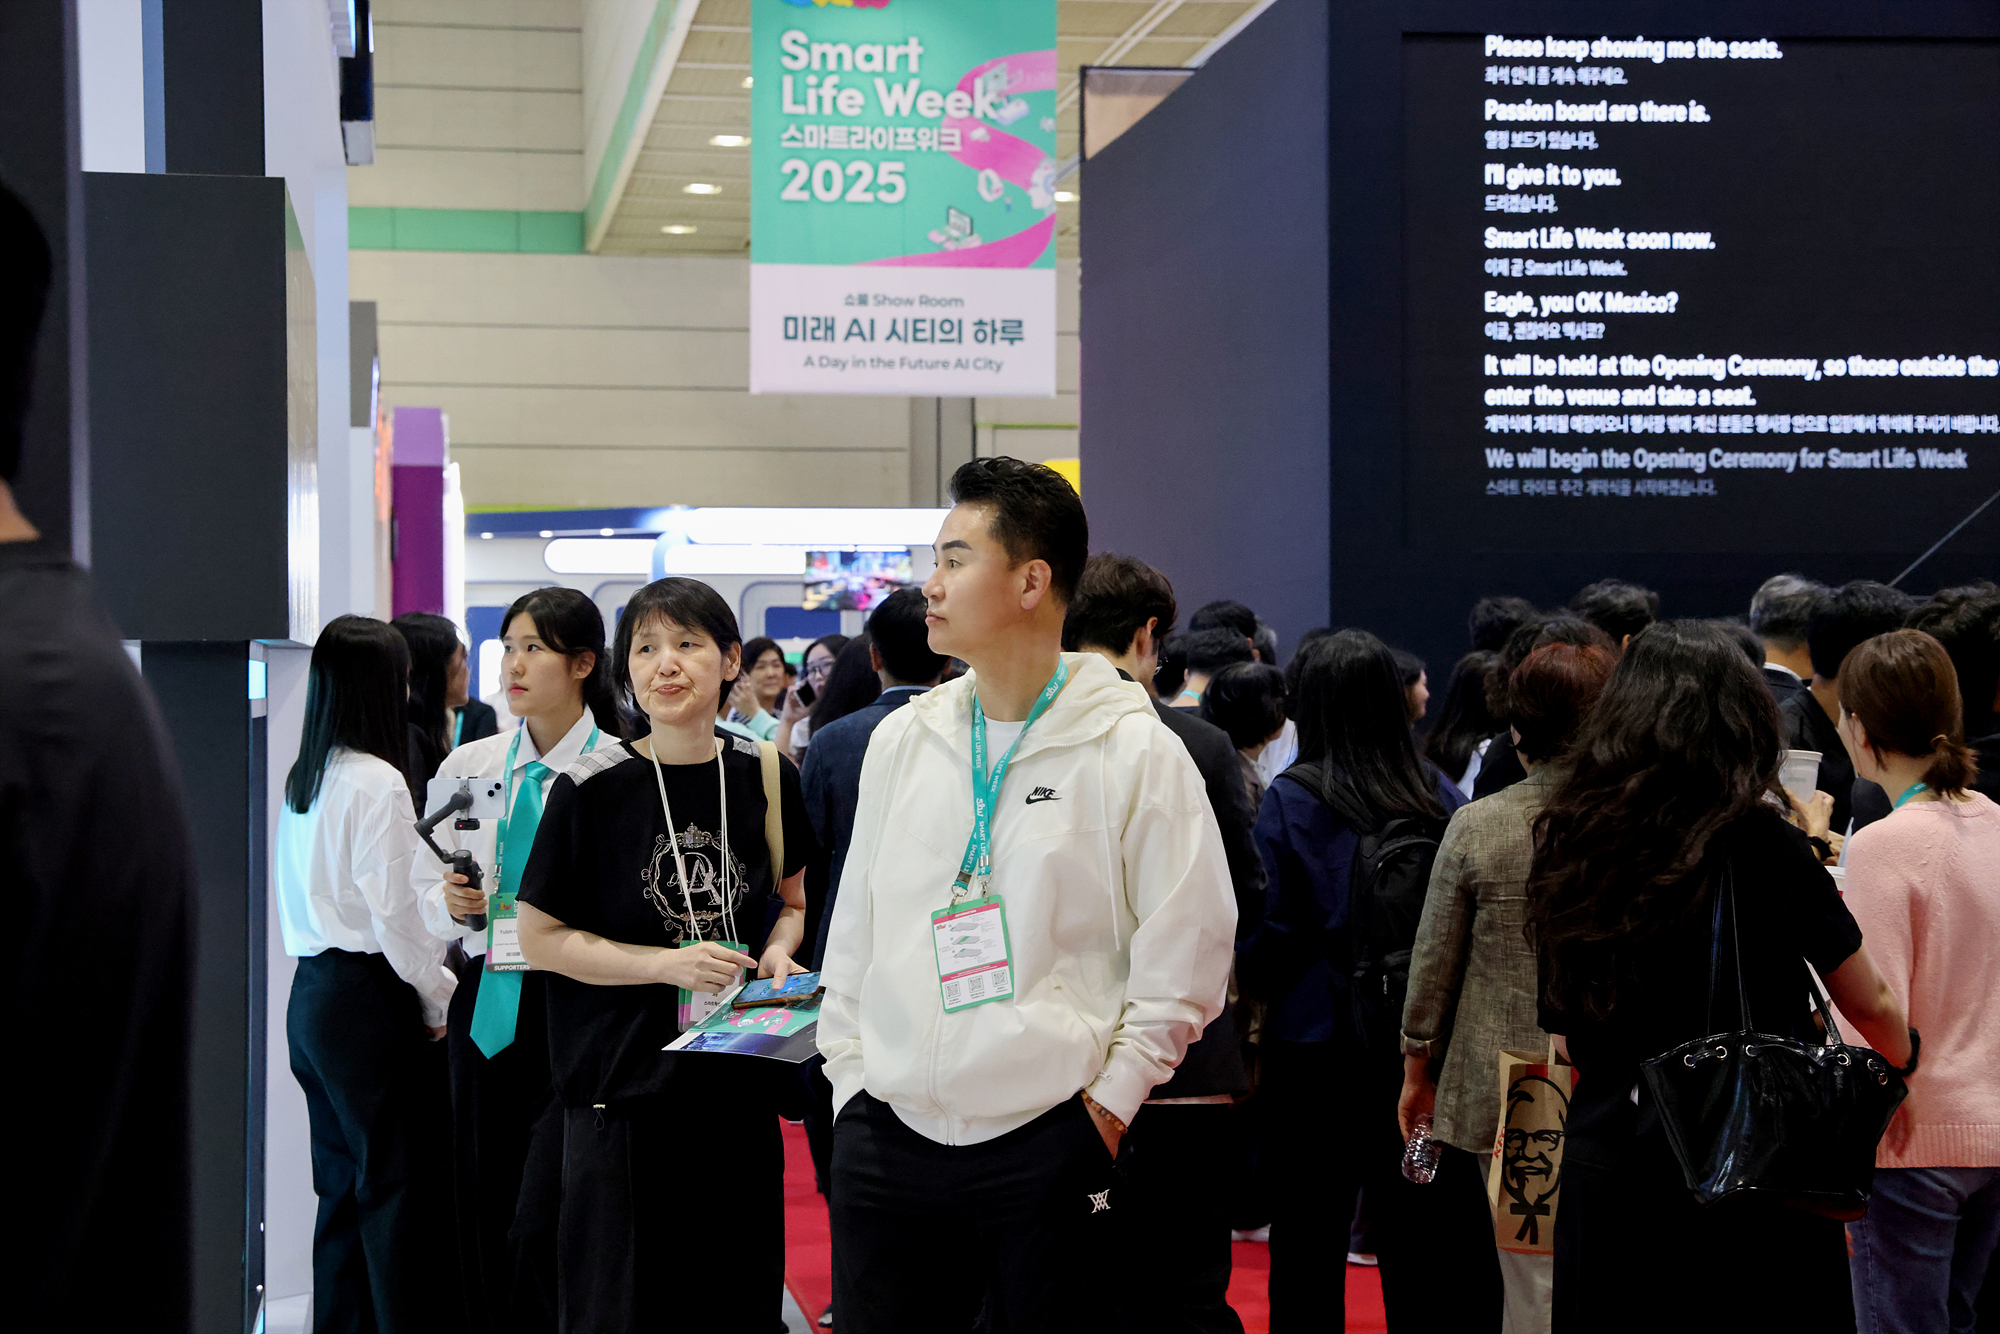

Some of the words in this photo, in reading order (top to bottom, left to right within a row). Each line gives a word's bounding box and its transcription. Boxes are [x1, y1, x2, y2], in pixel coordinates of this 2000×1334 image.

[780, 29, 924, 73] Smart
[1485, 35, 1544, 58] Please
[1546, 36, 1589, 63] keep
[1590, 36, 1665, 64] showing
[1666, 41, 1695, 59] me
[1697, 37, 1728, 59] the
[1729, 38, 1783, 60] seats.
[781, 74, 866, 116] Life
[874, 76, 999, 120] Week
[1485, 98, 1554, 122] Passion
[1555, 99, 1607, 122] board
[1608, 104, 1638, 122] are
[1639, 100, 1688, 122] there
[1689, 99, 1711, 123] is.
[780, 124, 962, 152] 스마트라이프위크
[780, 158, 907, 204] 2025
[1485, 163, 1505, 185] I'll
[1506, 162, 1545, 190] give
[1546, 163, 1560, 185] it
[1561, 165, 1581, 186] to
[1582, 169, 1622, 191] you.
[1485, 226, 1539, 249] Smart
[1540, 226, 1574, 249] Life
[1575, 227, 1625, 249] Week
[1626, 231, 1671, 250] soon
[1672, 231, 1716, 250] now.
[1525, 258, 1564, 276] Smart
[1564, 259, 1588, 276] Life
[1589, 259, 1628, 276] Week.
[872, 294, 915, 307] Show
[919, 294, 964, 307] Room
[1485, 291, 1539, 318] Eagle,
[1540, 295, 1574, 317] you
[1575, 291, 1604, 313] OK
[1605, 290, 1679, 313] Mexico?
[783, 315, 835, 342] 미래
[843, 317, 875, 342] AI
[885, 317, 963, 344] 시티의
[973, 318, 1024, 346] 하루
[803, 356, 817, 368] A
[819, 356, 849, 372] Day
[851, 355, 865, 368] in
[869, 356, 896, 369] the
[900, 357, 951, 370] Future
[954, 358, 970, 370] AI
[972, 358, 1004, 373] City
[1485, 354, 1499, 376] It
[1500, 353, 1532, 376] will
[1533, 354, 1557, 376] be
[1558, 354, 1598, 376] held
[1599, 355, 1618, 376] at
[1619, 355, 1651, 376] the
[1652, 354, 1726, 381] Opening
[1727, 354, 1822, 381] Ceremony,
[1823, 358, 1846, 376] so
[1847, 355, 1899, 376] those
[1900, 354, 1966, 376] outside
[1967, 354, 1998, 376] the
[1485, 385, 1533, 406] enter
[1534, 385, 1564, 406] the
[1565, 389, 1620, 406] venue
[1621, 384, 1656, 406] and
[1657, 385, 1697, 406] take
[1698, 389, 1711, 406] a
[1712, 385, 1757, 406] seat.
[1485, 448, 1514, 468] We
[1516, 447, 1547, 468] will
[1550, 447, 1598, 473] begin
[1601, 448, 1631, 468] the
[1633, 447, 1706, 473] Opening
[1709, 448, 1798, 473] Ceremony
[1799, 447, 1826, 468] for
[1827, 448, 1881, 468] Smart
[1883, 447, 1916, 468] Life
[1917, 448, 1967, 468] Week
[1031, 786, 1056, 798] NIKE
